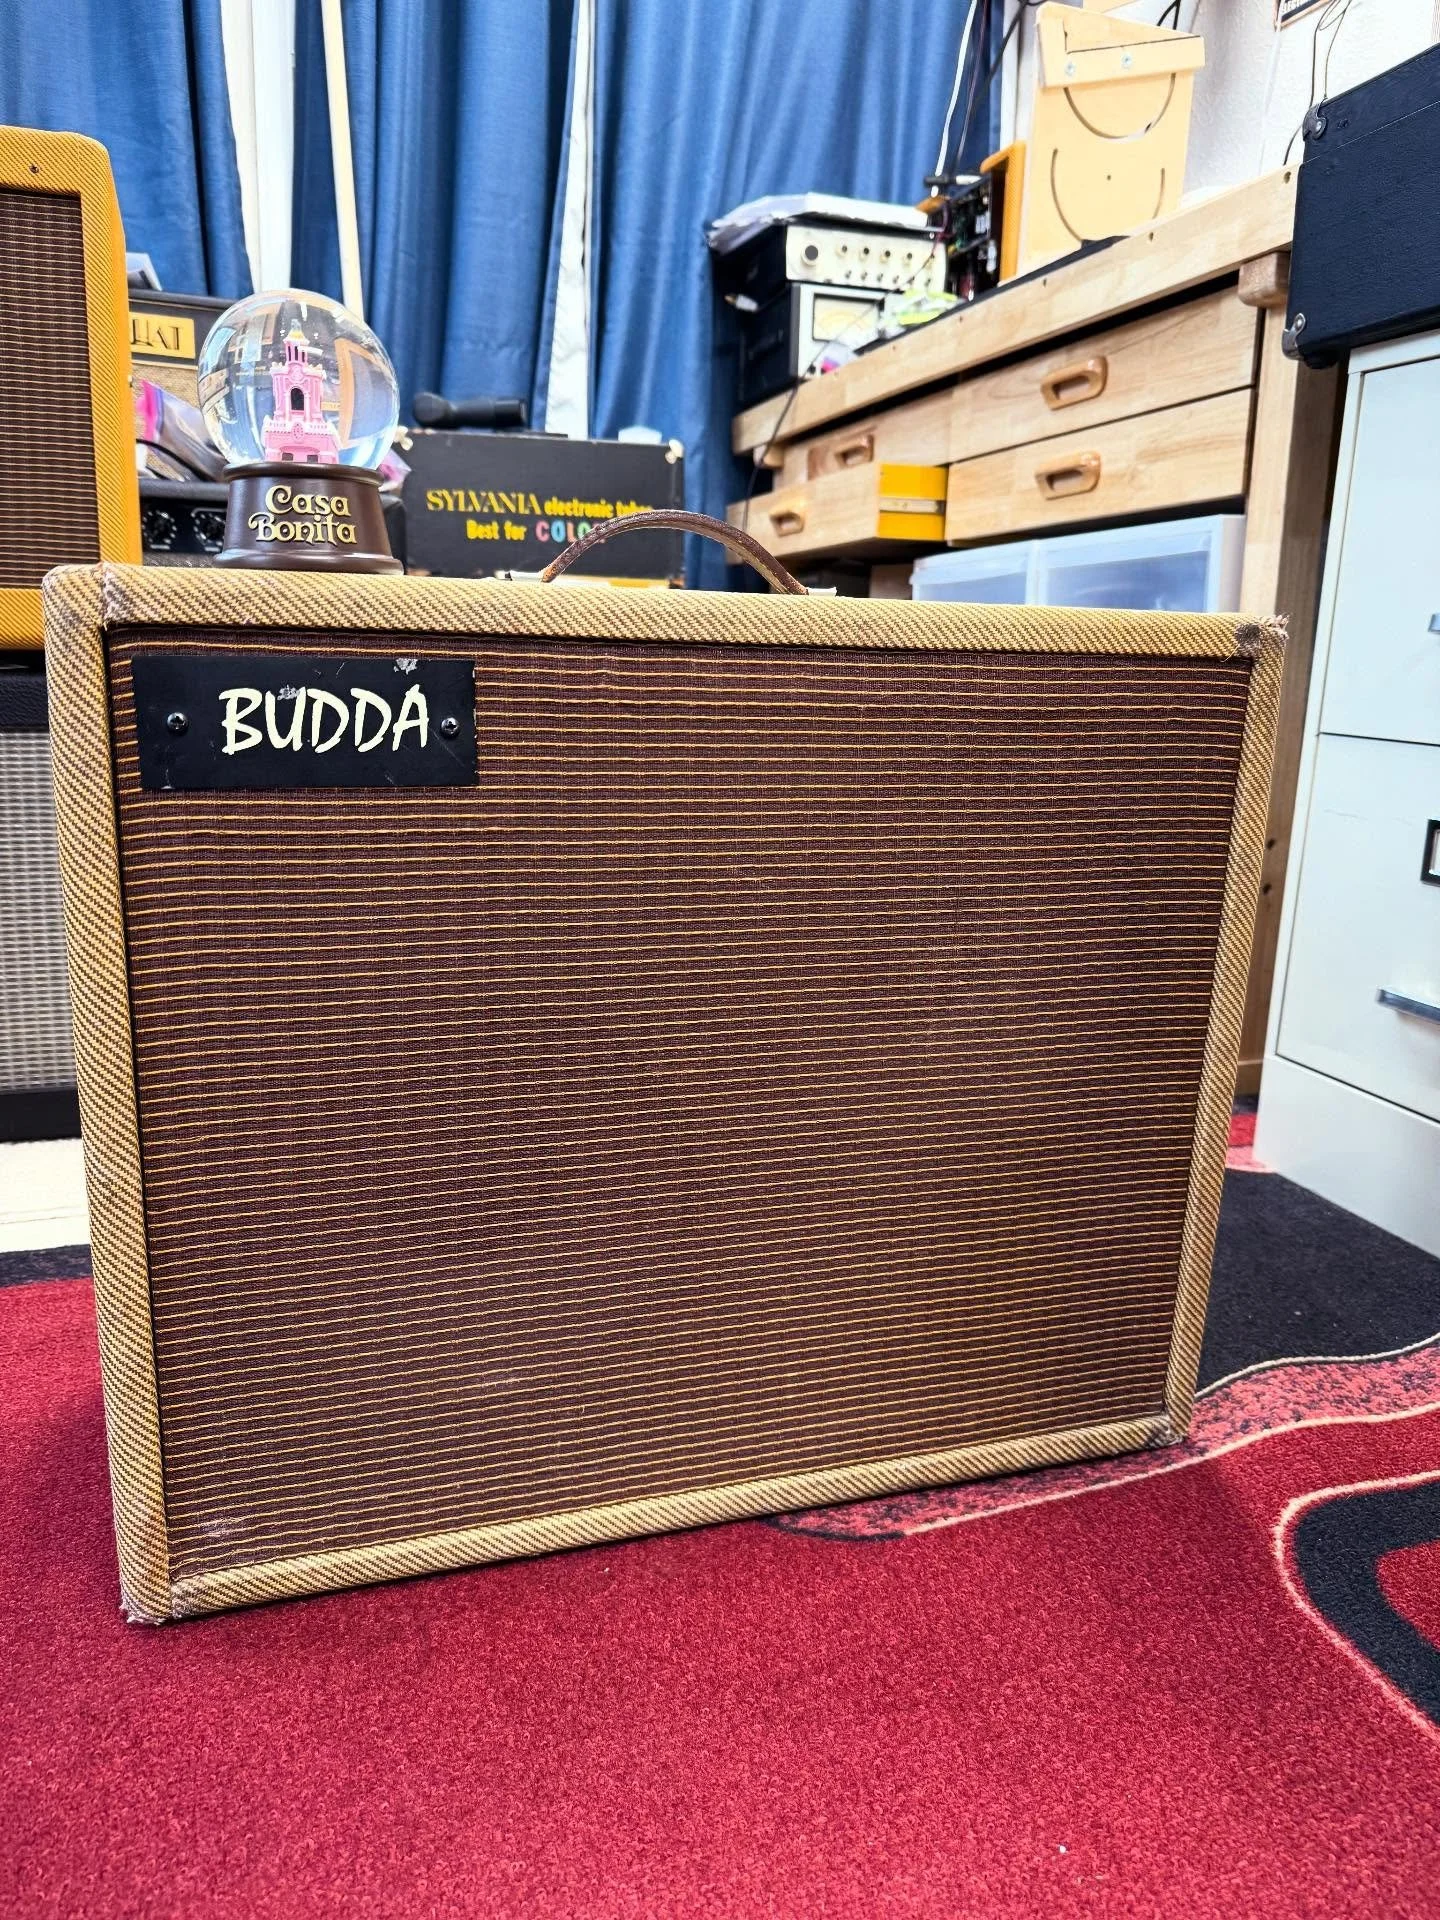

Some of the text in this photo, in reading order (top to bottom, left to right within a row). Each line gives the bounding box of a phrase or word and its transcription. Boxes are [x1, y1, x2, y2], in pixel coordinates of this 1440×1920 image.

[265, 485, 352, 517] Casa
[426, 489, 542, 515] SYLVANIA
[544, 496, 614, 519] electronic
[248, 511, 357, 546] Bonita
[466, 519, 500, 541] Best
[504, 520, 527, 541] for
[218, 683, 430, 756] BUDDA
